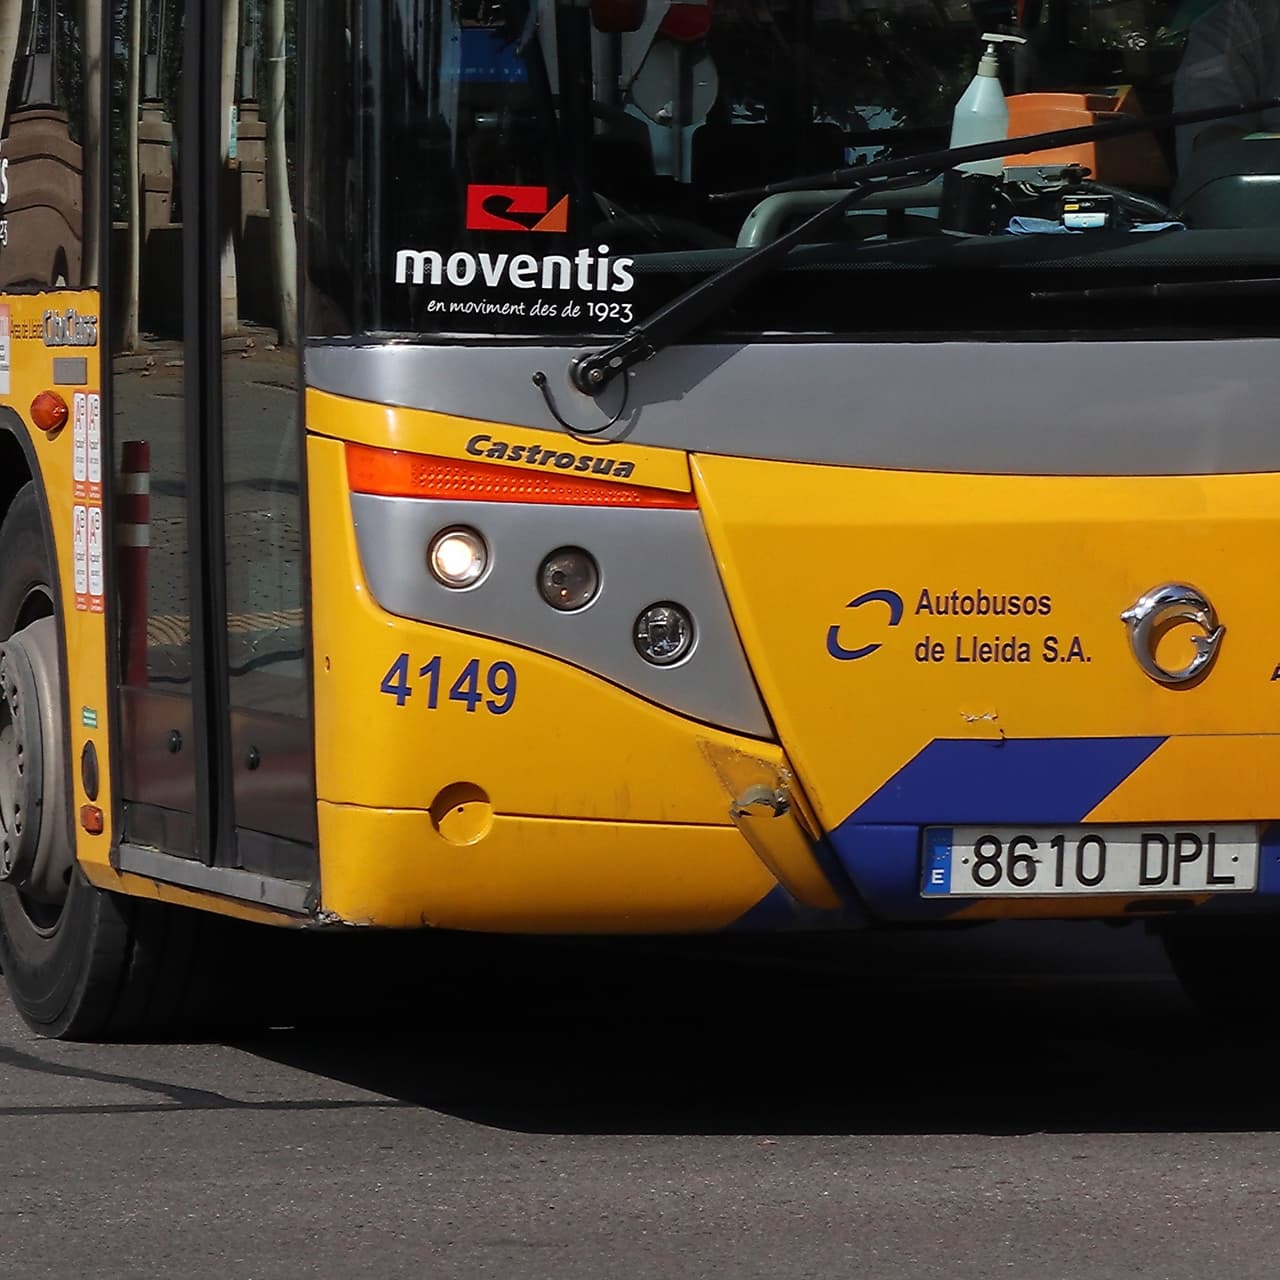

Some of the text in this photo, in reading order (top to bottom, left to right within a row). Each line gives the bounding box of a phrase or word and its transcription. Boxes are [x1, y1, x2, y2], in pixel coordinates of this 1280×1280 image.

[395, 244, 634, 292] moventis
[427, 298, 634, 323] en moviment des de 1923
[465, 434, 636, 478] Castrosua
[914, 588, 1052, 616] Autobusos
[914, 635, 1091, 663] de Lleida S.A.
[380, 653, 517, 714] 4149
[931, 869, 945, 884] E
[971, 832, 1236, 888] 8610 DPL
